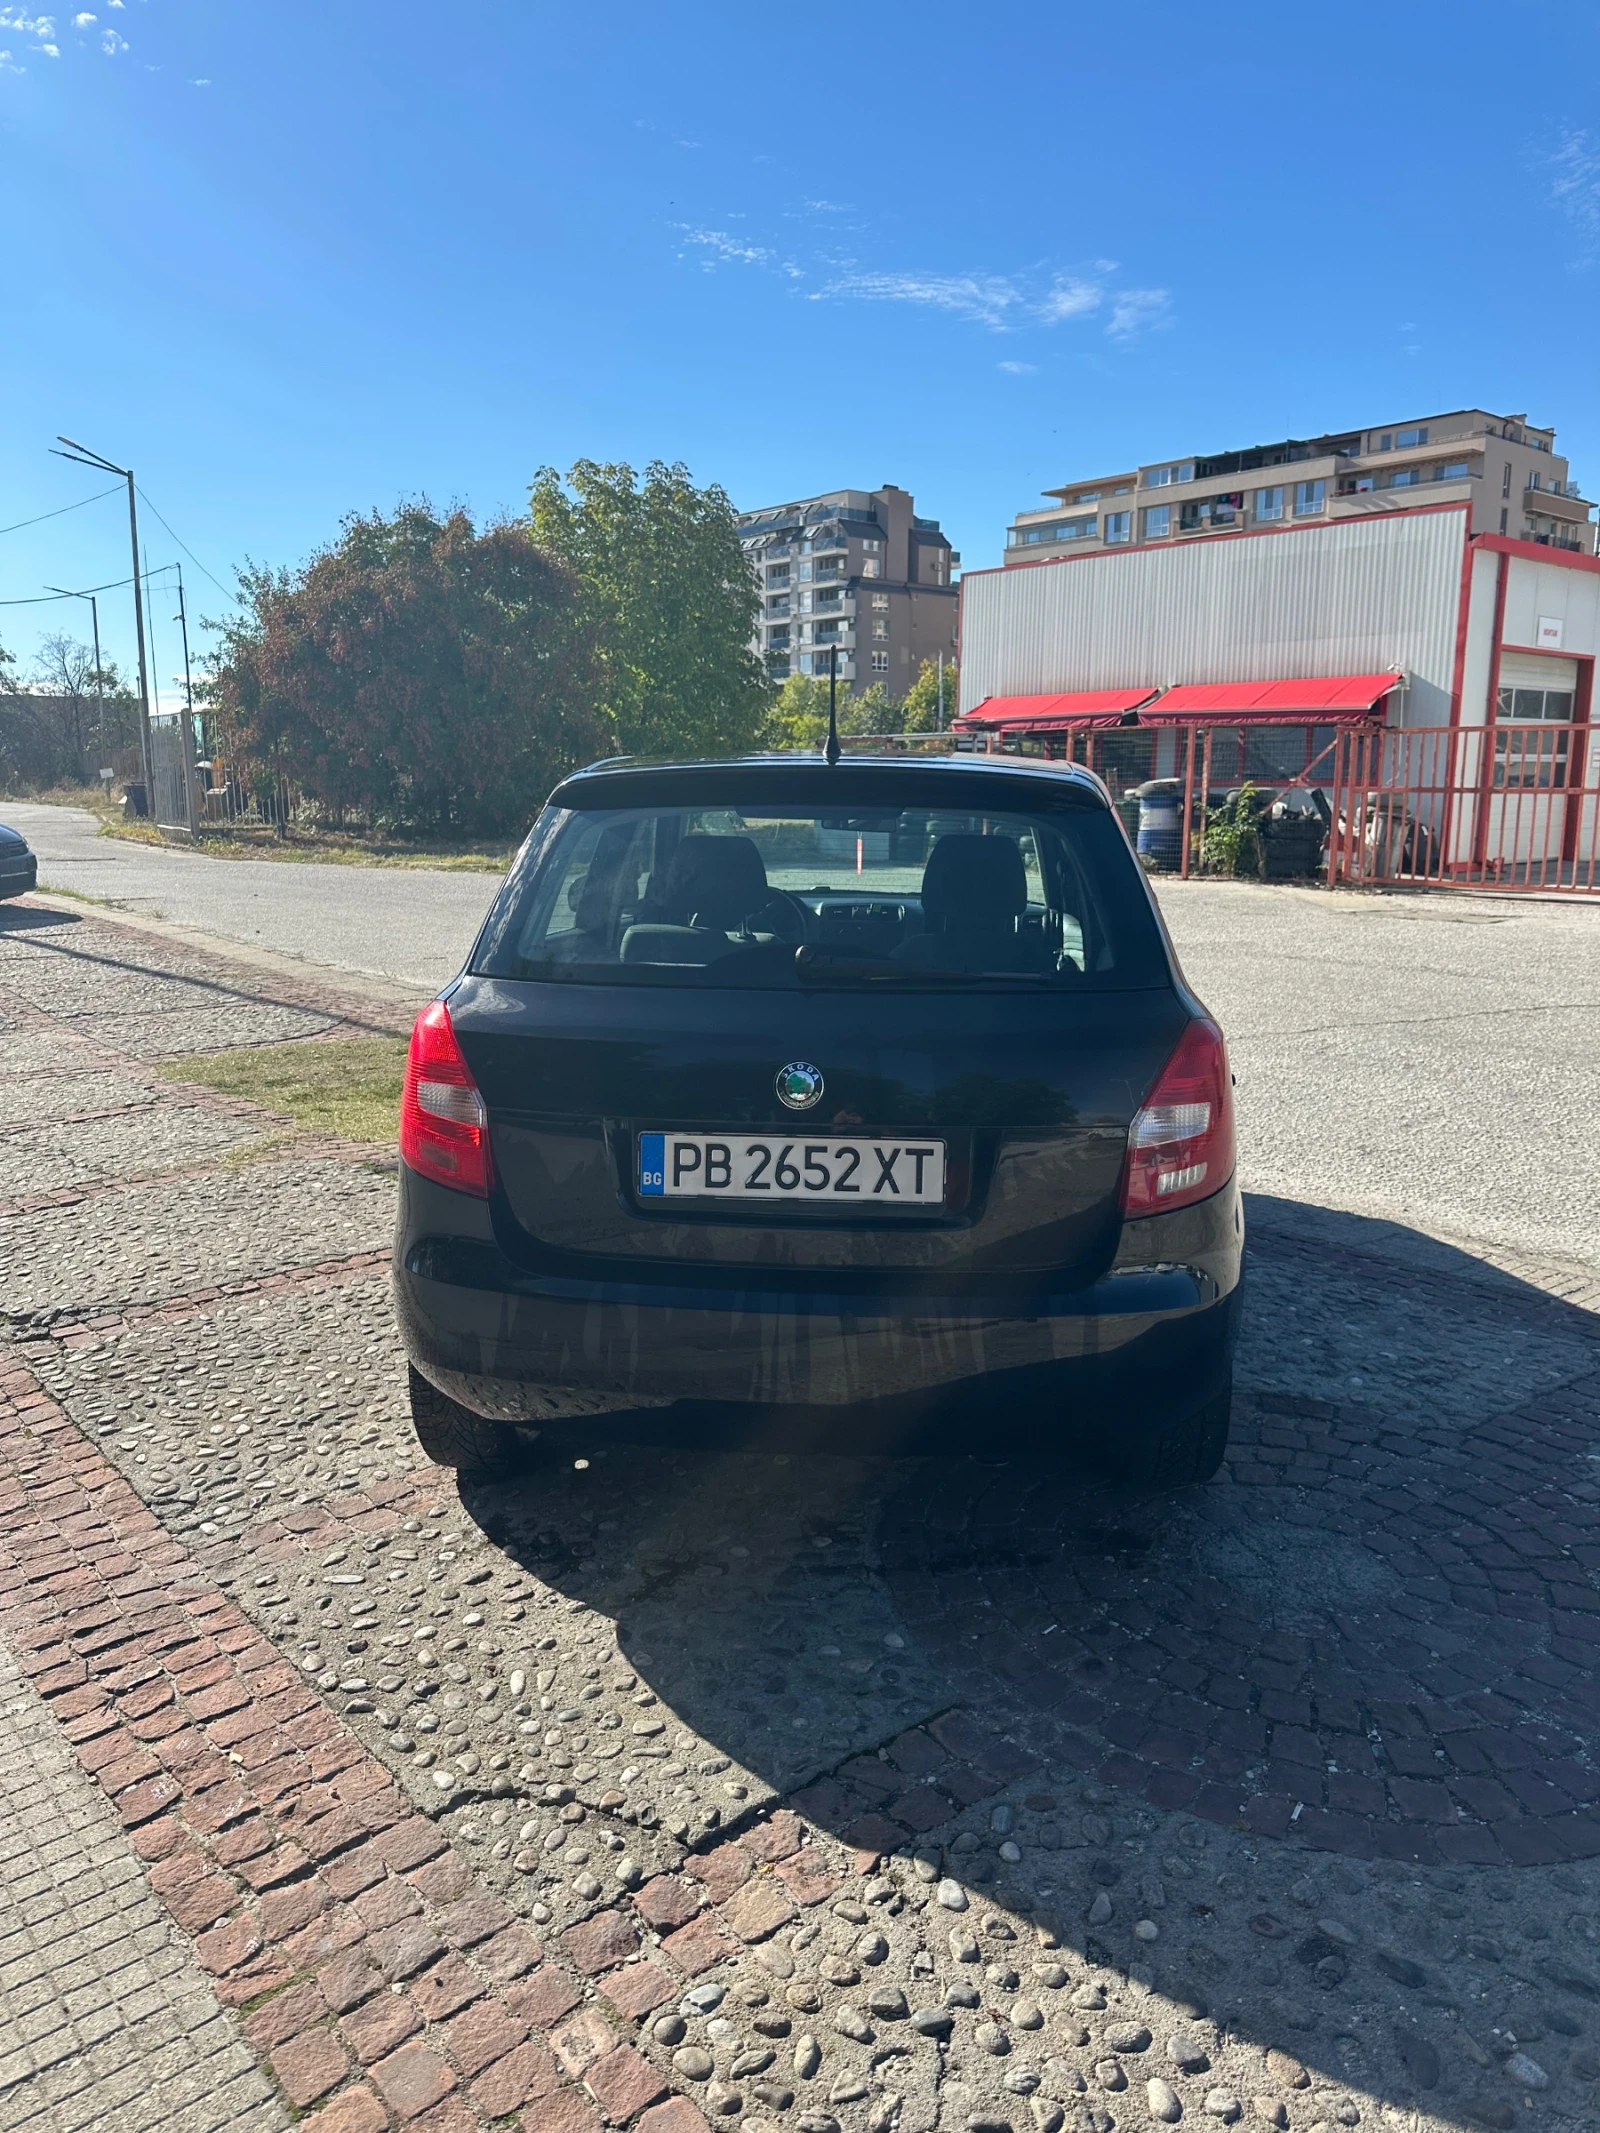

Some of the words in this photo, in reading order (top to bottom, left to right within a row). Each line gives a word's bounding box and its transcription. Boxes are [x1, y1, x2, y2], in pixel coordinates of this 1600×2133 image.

[643, 1171, 662, 1186] BG
[673, 1142, 732, 1188] PB
[745, 1144, 860, 1193] 2652
[873, 1148, 934, 1195] XT
